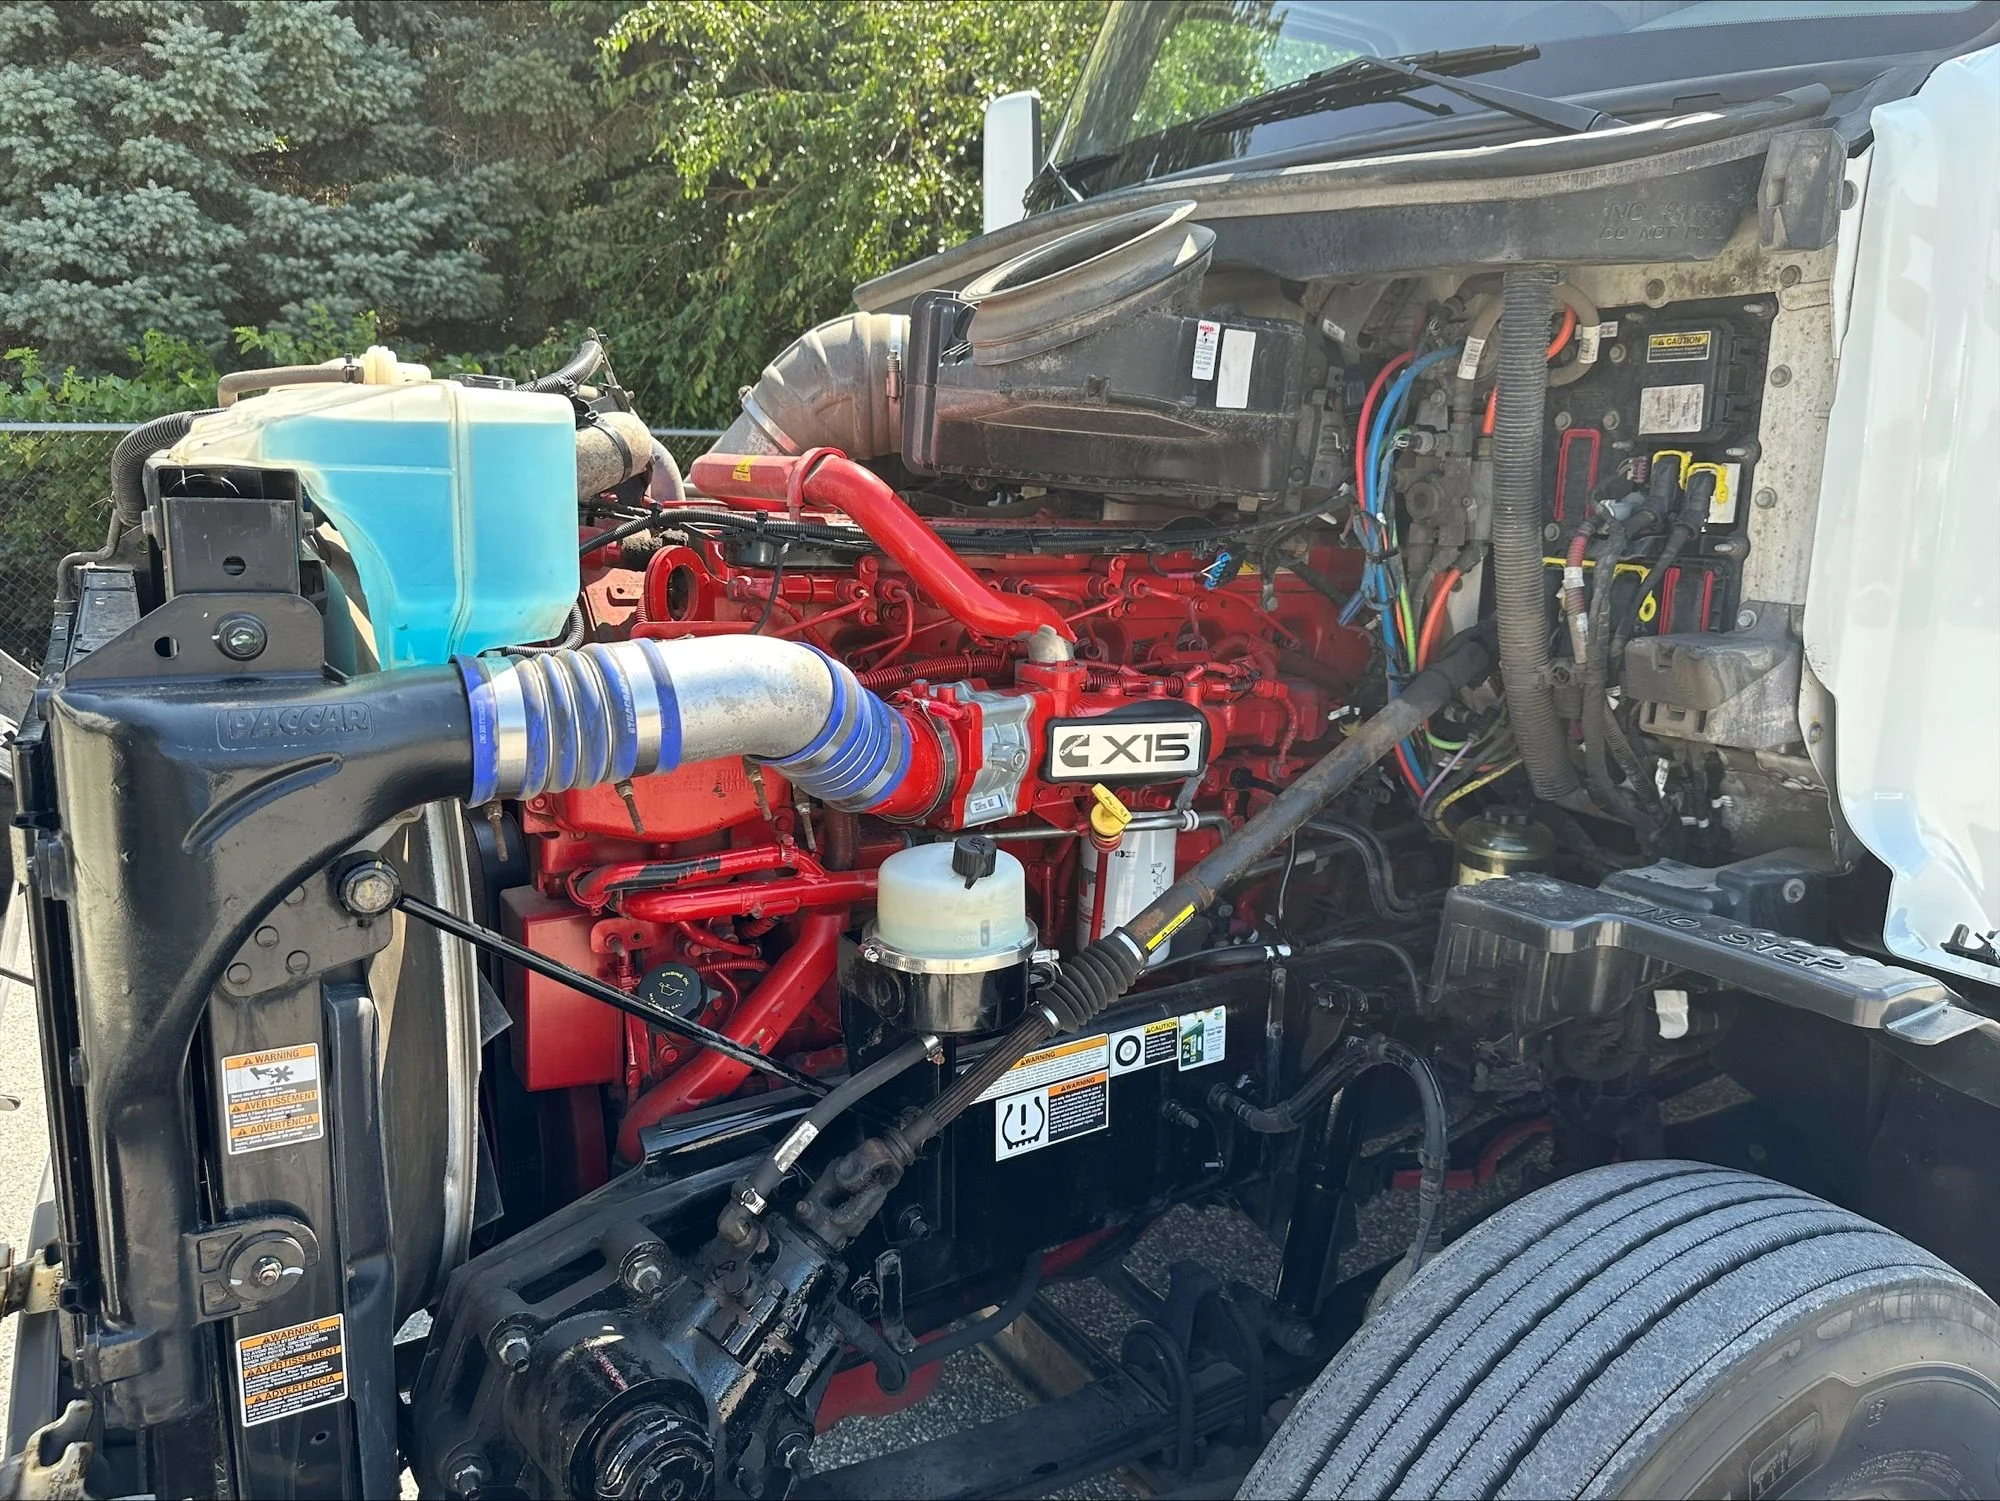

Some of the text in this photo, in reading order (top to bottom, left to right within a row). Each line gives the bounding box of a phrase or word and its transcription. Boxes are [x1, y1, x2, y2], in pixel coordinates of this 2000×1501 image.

[1640, 224, 1678, 240] NOT
[1666, 337, 1701, 345] CAUTION
[226, 704, 369, 739] PACCAR
[1100, 733, 1190, 764] X15
[1638, 907, 1848, 971] NO STEP
[1150, 1020, 1177, 1033] CAUTION
[255, 1049, 299, 1064] WARNING
[1025, 1051, 1056, 1065] WARNING
[1066, 1077, 1096, 1090] WARNING
[244, 1091, 316, 1111] AVERTISSEMENT
[250, 1115, 314, 1133] ADVERTENCIA
[271, 1323, 320, 1341] WARNING
[254, 1347, 338, 1374] AVERTISSEMENT
[265, 1375, 335, 1400] ADVERTENCIA
